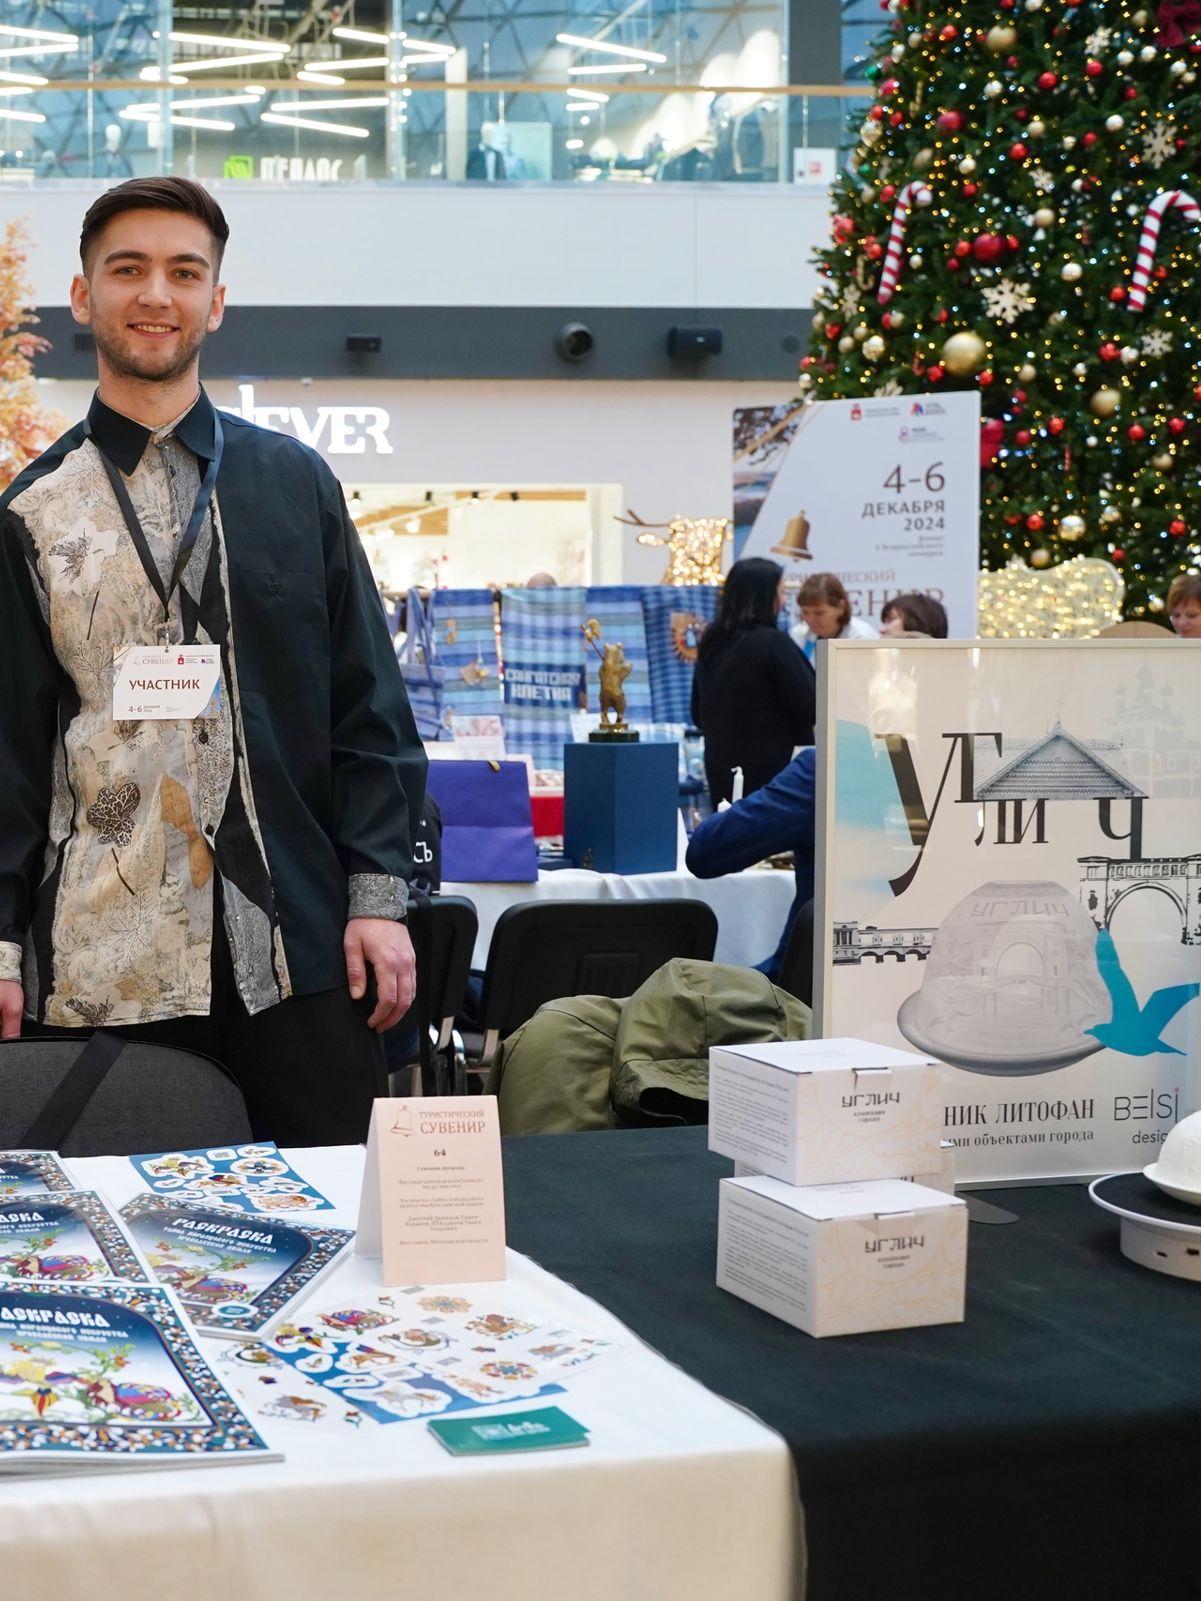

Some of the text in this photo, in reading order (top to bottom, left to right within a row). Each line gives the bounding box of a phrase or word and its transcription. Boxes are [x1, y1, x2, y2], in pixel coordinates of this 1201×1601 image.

[862, 500, 944, 519] ДЕКАБРЯ
[904, 518, 944, 532] 2024
[129, 679, 200, 690] УЧАСТНИК
[842, 1092, 900, 1107] УГЛИЧ
[419, 1110, 485, 1119] ТУРИСТИЧЕСКИЙ
[995, 1099, 1095, 1124] ЛИТОФАН
[420, 1121, 486, 1134] СУВЕНИР
[974, 1133, 1046, 1147] объектами
[1049, 1130, 1094, 1143] города
[1132, 1129, 1168, 1145] desig
[433, 1149, 447, 1157] 64
[172, 1218, 273, 1244] РАСКРАСКА
[865, 1235, 924, 1253] УГЛИЧ
